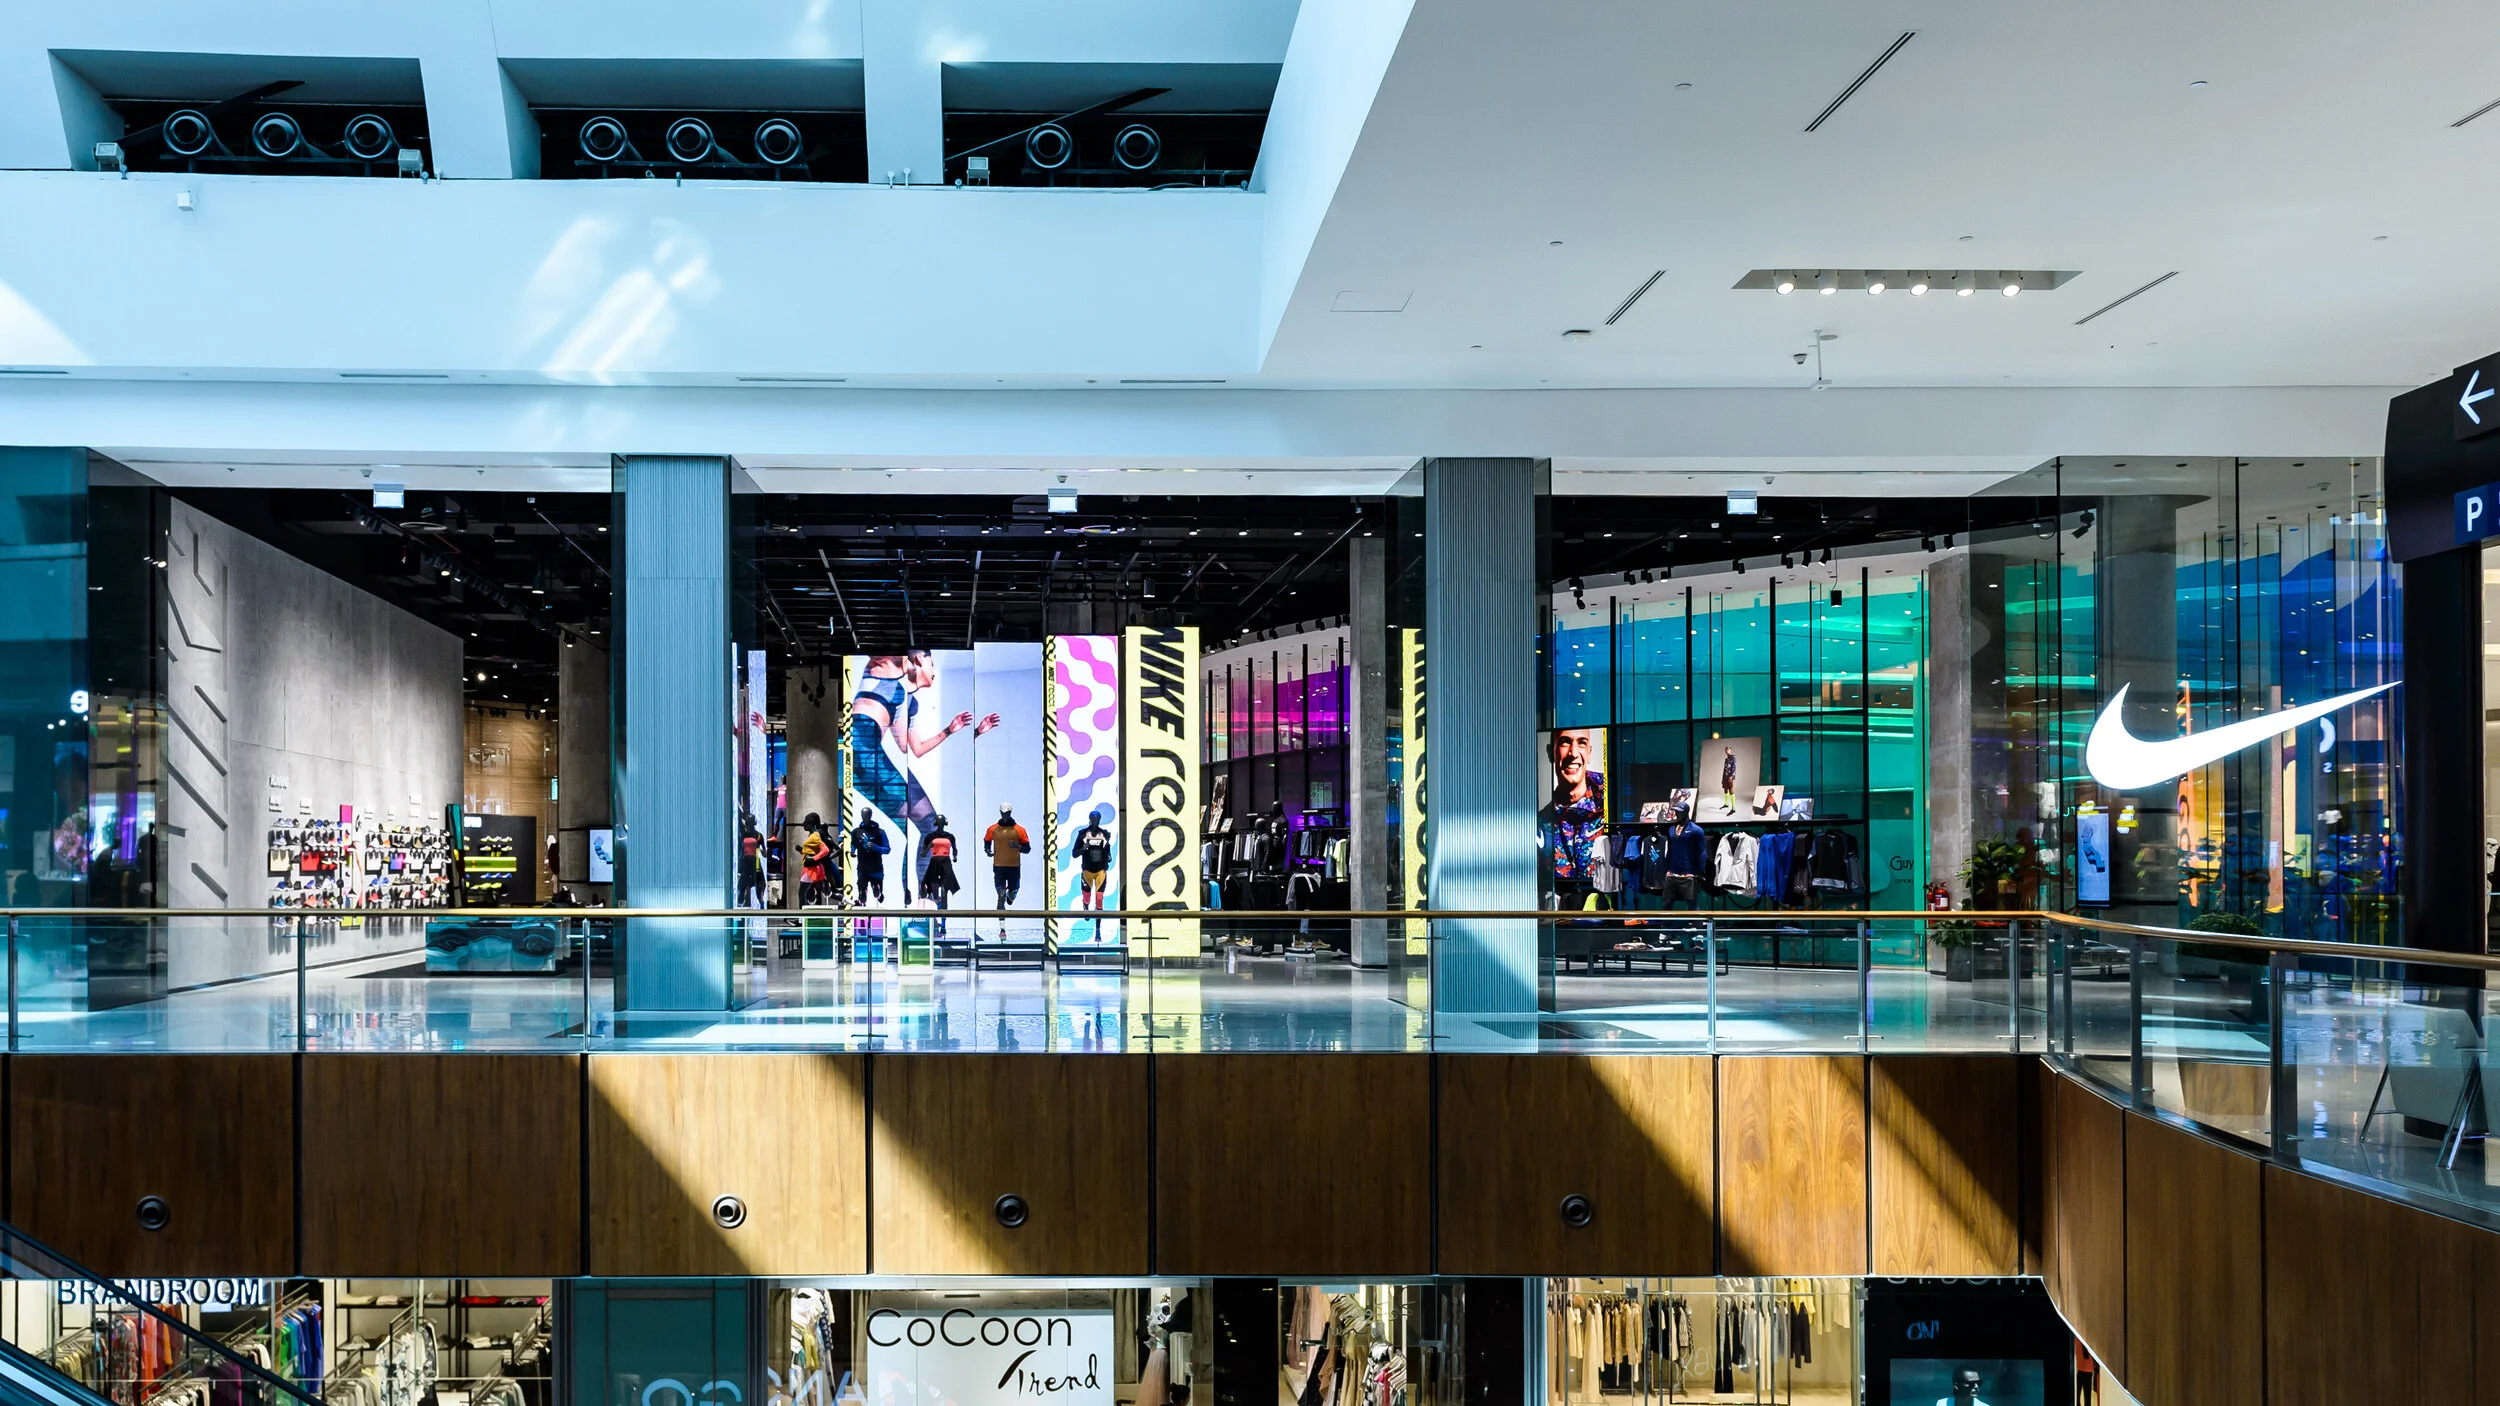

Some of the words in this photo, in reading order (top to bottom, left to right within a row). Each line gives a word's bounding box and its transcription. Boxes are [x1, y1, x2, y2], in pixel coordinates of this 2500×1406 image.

[2467, 496, 2483, 532] P
[1140, 627, 1185, 740] NIKE
[866, 1308, 1072, 1347] CoCoon
[997, 1349, 1101, 1398] Trend
